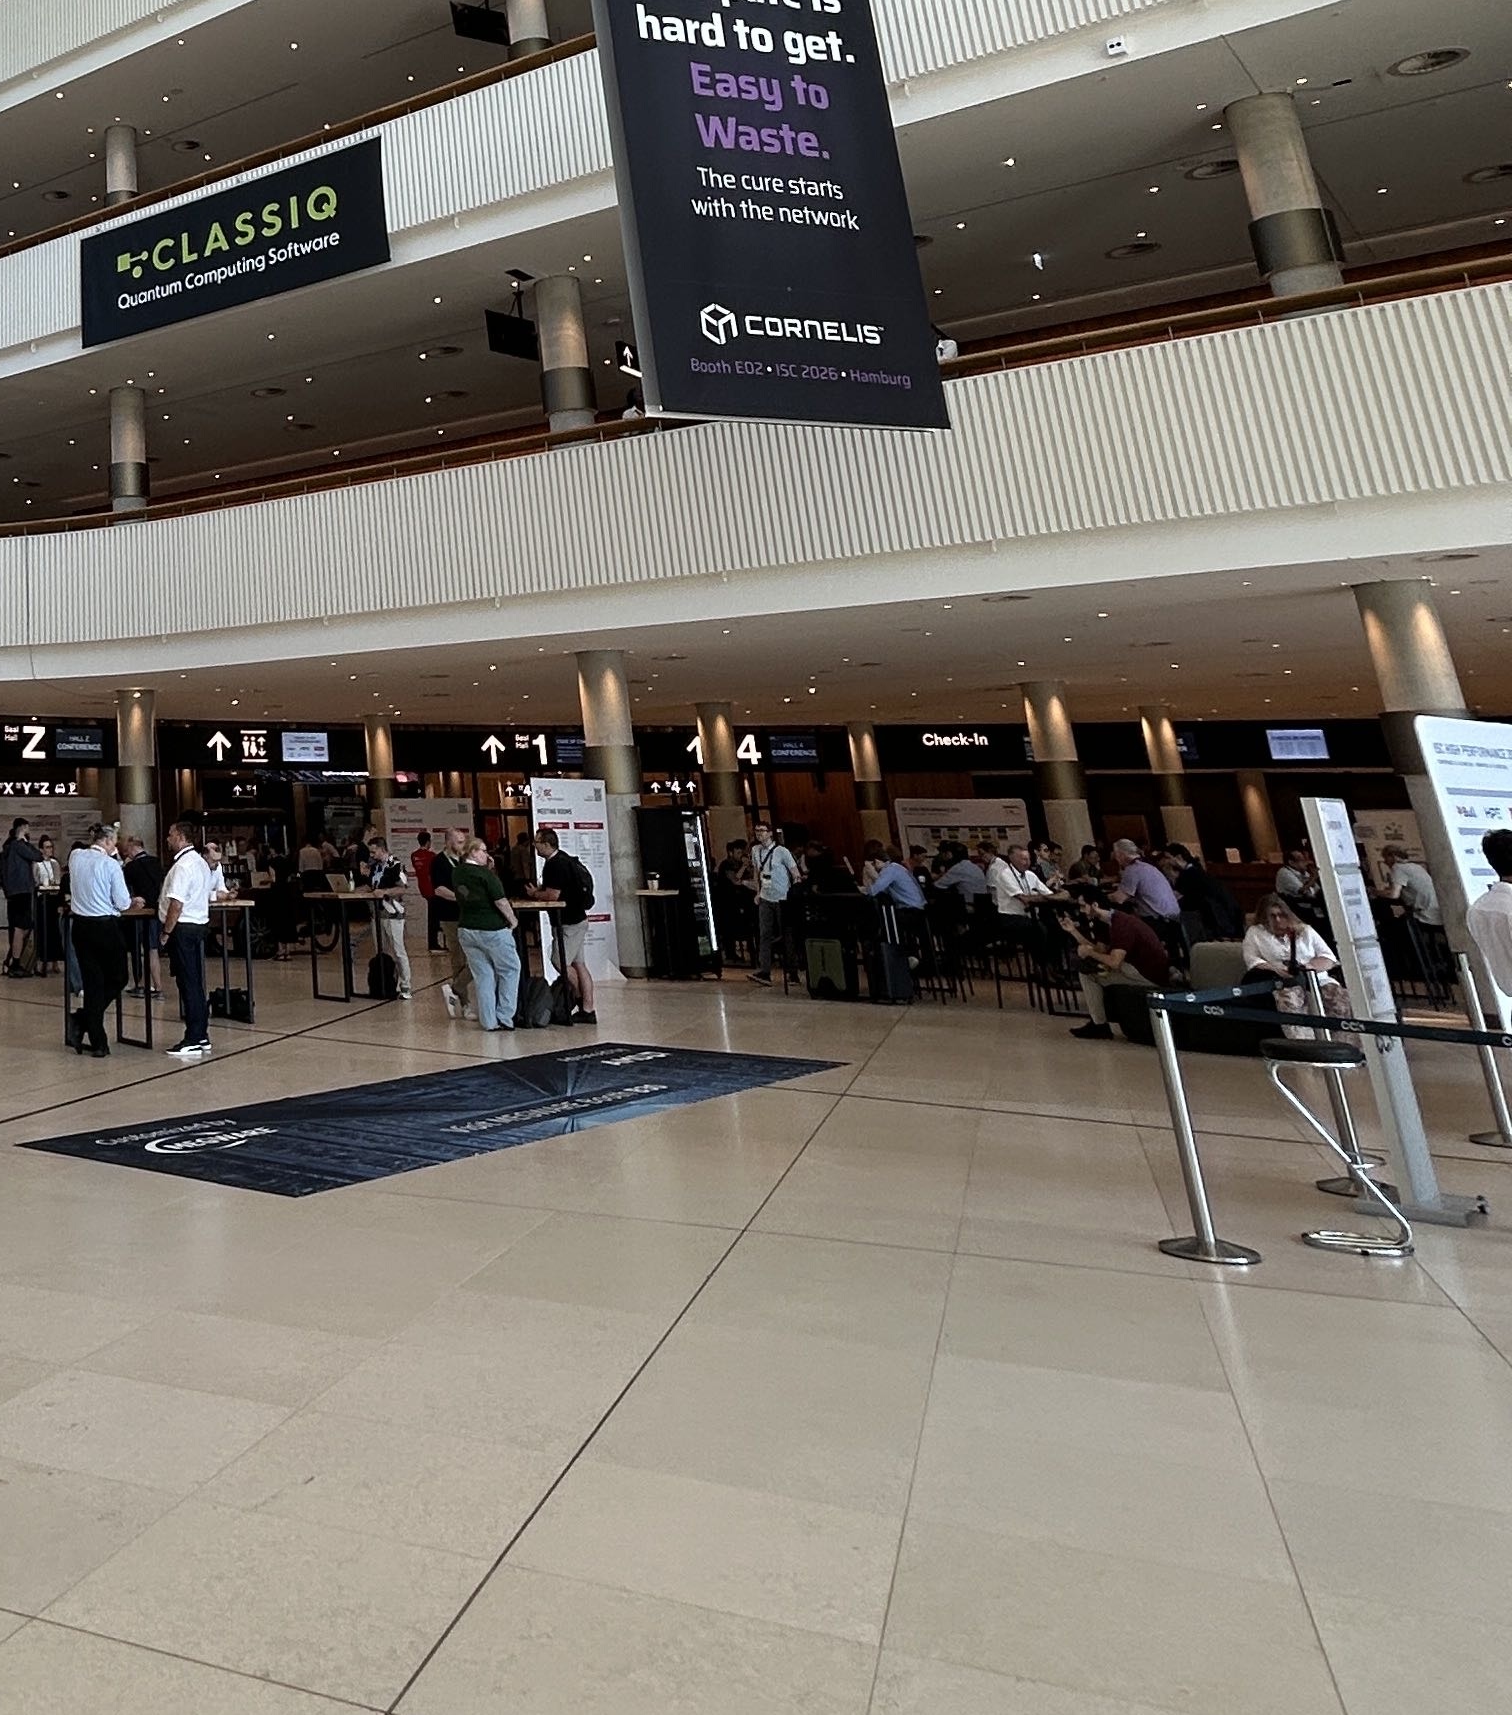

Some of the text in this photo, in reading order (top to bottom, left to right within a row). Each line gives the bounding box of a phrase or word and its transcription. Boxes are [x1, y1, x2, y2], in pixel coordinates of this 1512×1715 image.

[635, 4, 856, 65] hard to get.
[690, 61, 830, 112] Easy to
[695, 113, 830, 160] Waste.
[696, 166, 844, 200] The cure starts
[152, 185, 338, 271] CLASSIQ
[691, 196, 860, 231] with the network
[117, 231, 340, 310] Quantum Computing Software
[690, 358, 912, 388] Booth E02 ISC 2026 Hamburg
[22, 726, 46, 759] Z
[532, 734, 548, 765] 1
[737, 734, 761, 765] 4
[922, 732, 989, 747] Check-In
[3, 782, 14, 795] X
[22, 782, 32, 795] Y
[39, 782, 49, 795] Z
[163, 1126, 279, 1150] MEGWARE
